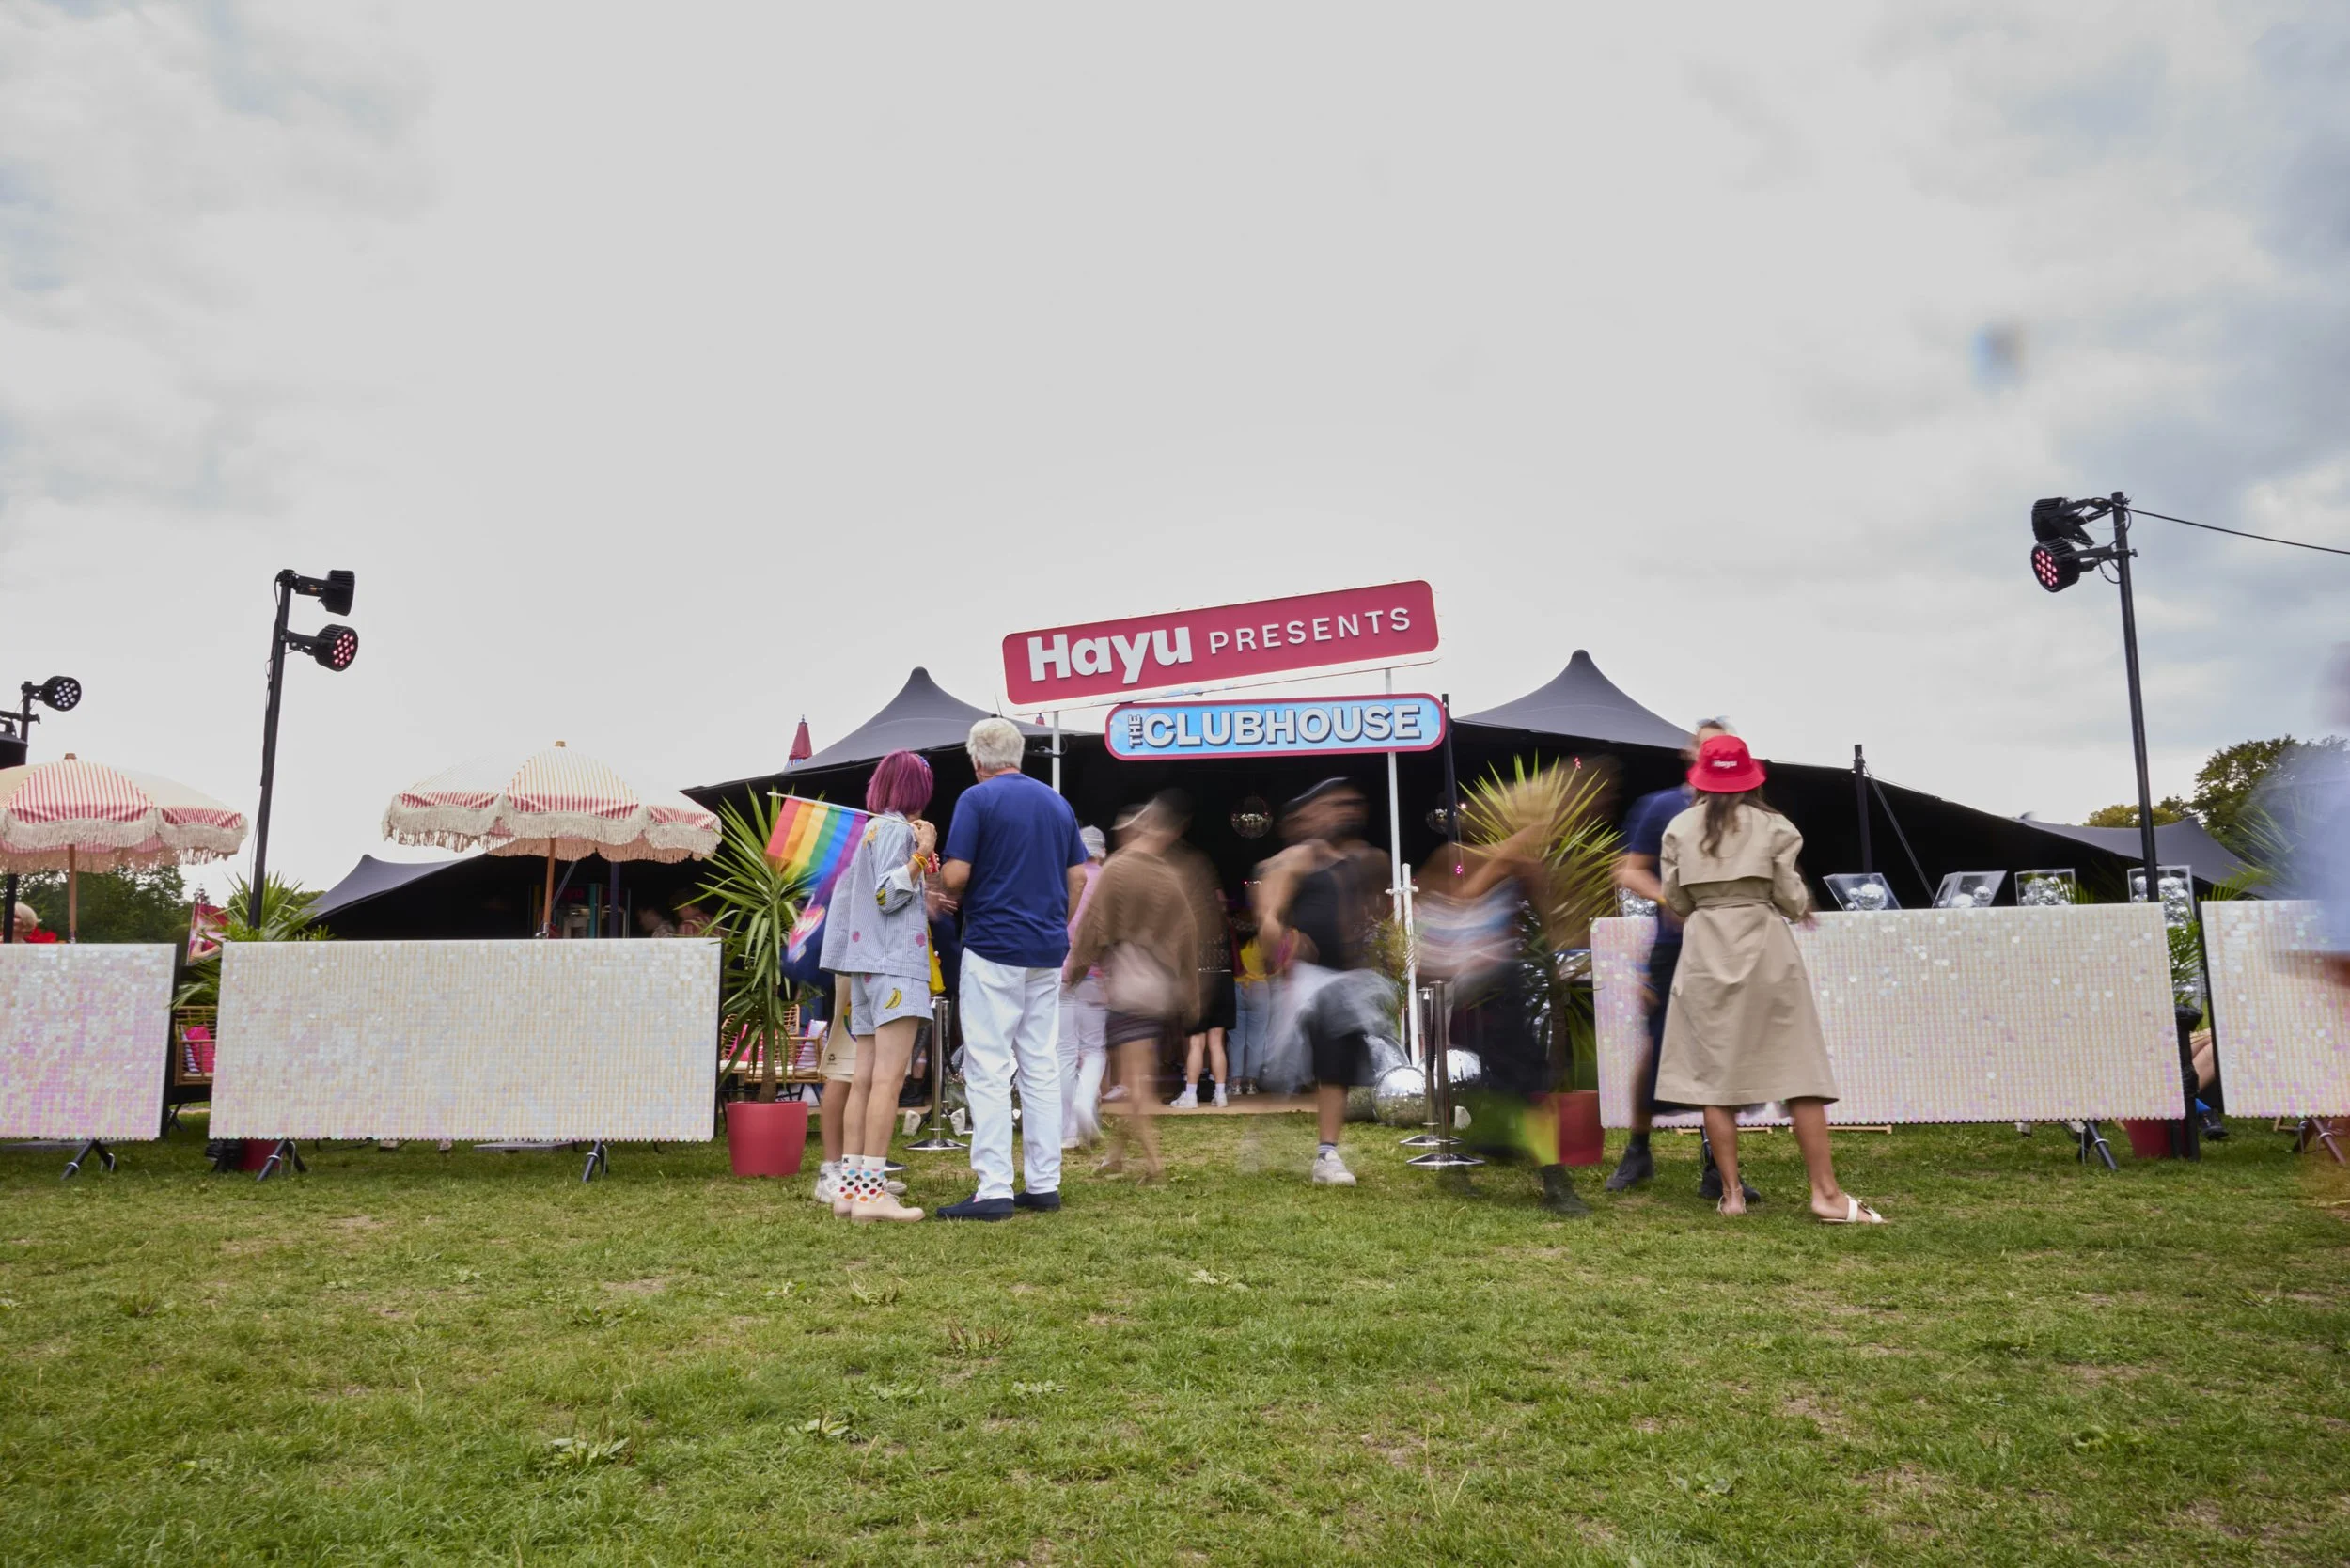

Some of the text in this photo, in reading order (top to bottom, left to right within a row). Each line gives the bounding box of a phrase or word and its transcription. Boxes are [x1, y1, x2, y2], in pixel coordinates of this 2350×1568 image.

[1027, 607, 1412, 684] Hayu PRESENTS
[1128, 704, 1422, 748] THE CLUBHOUSE
